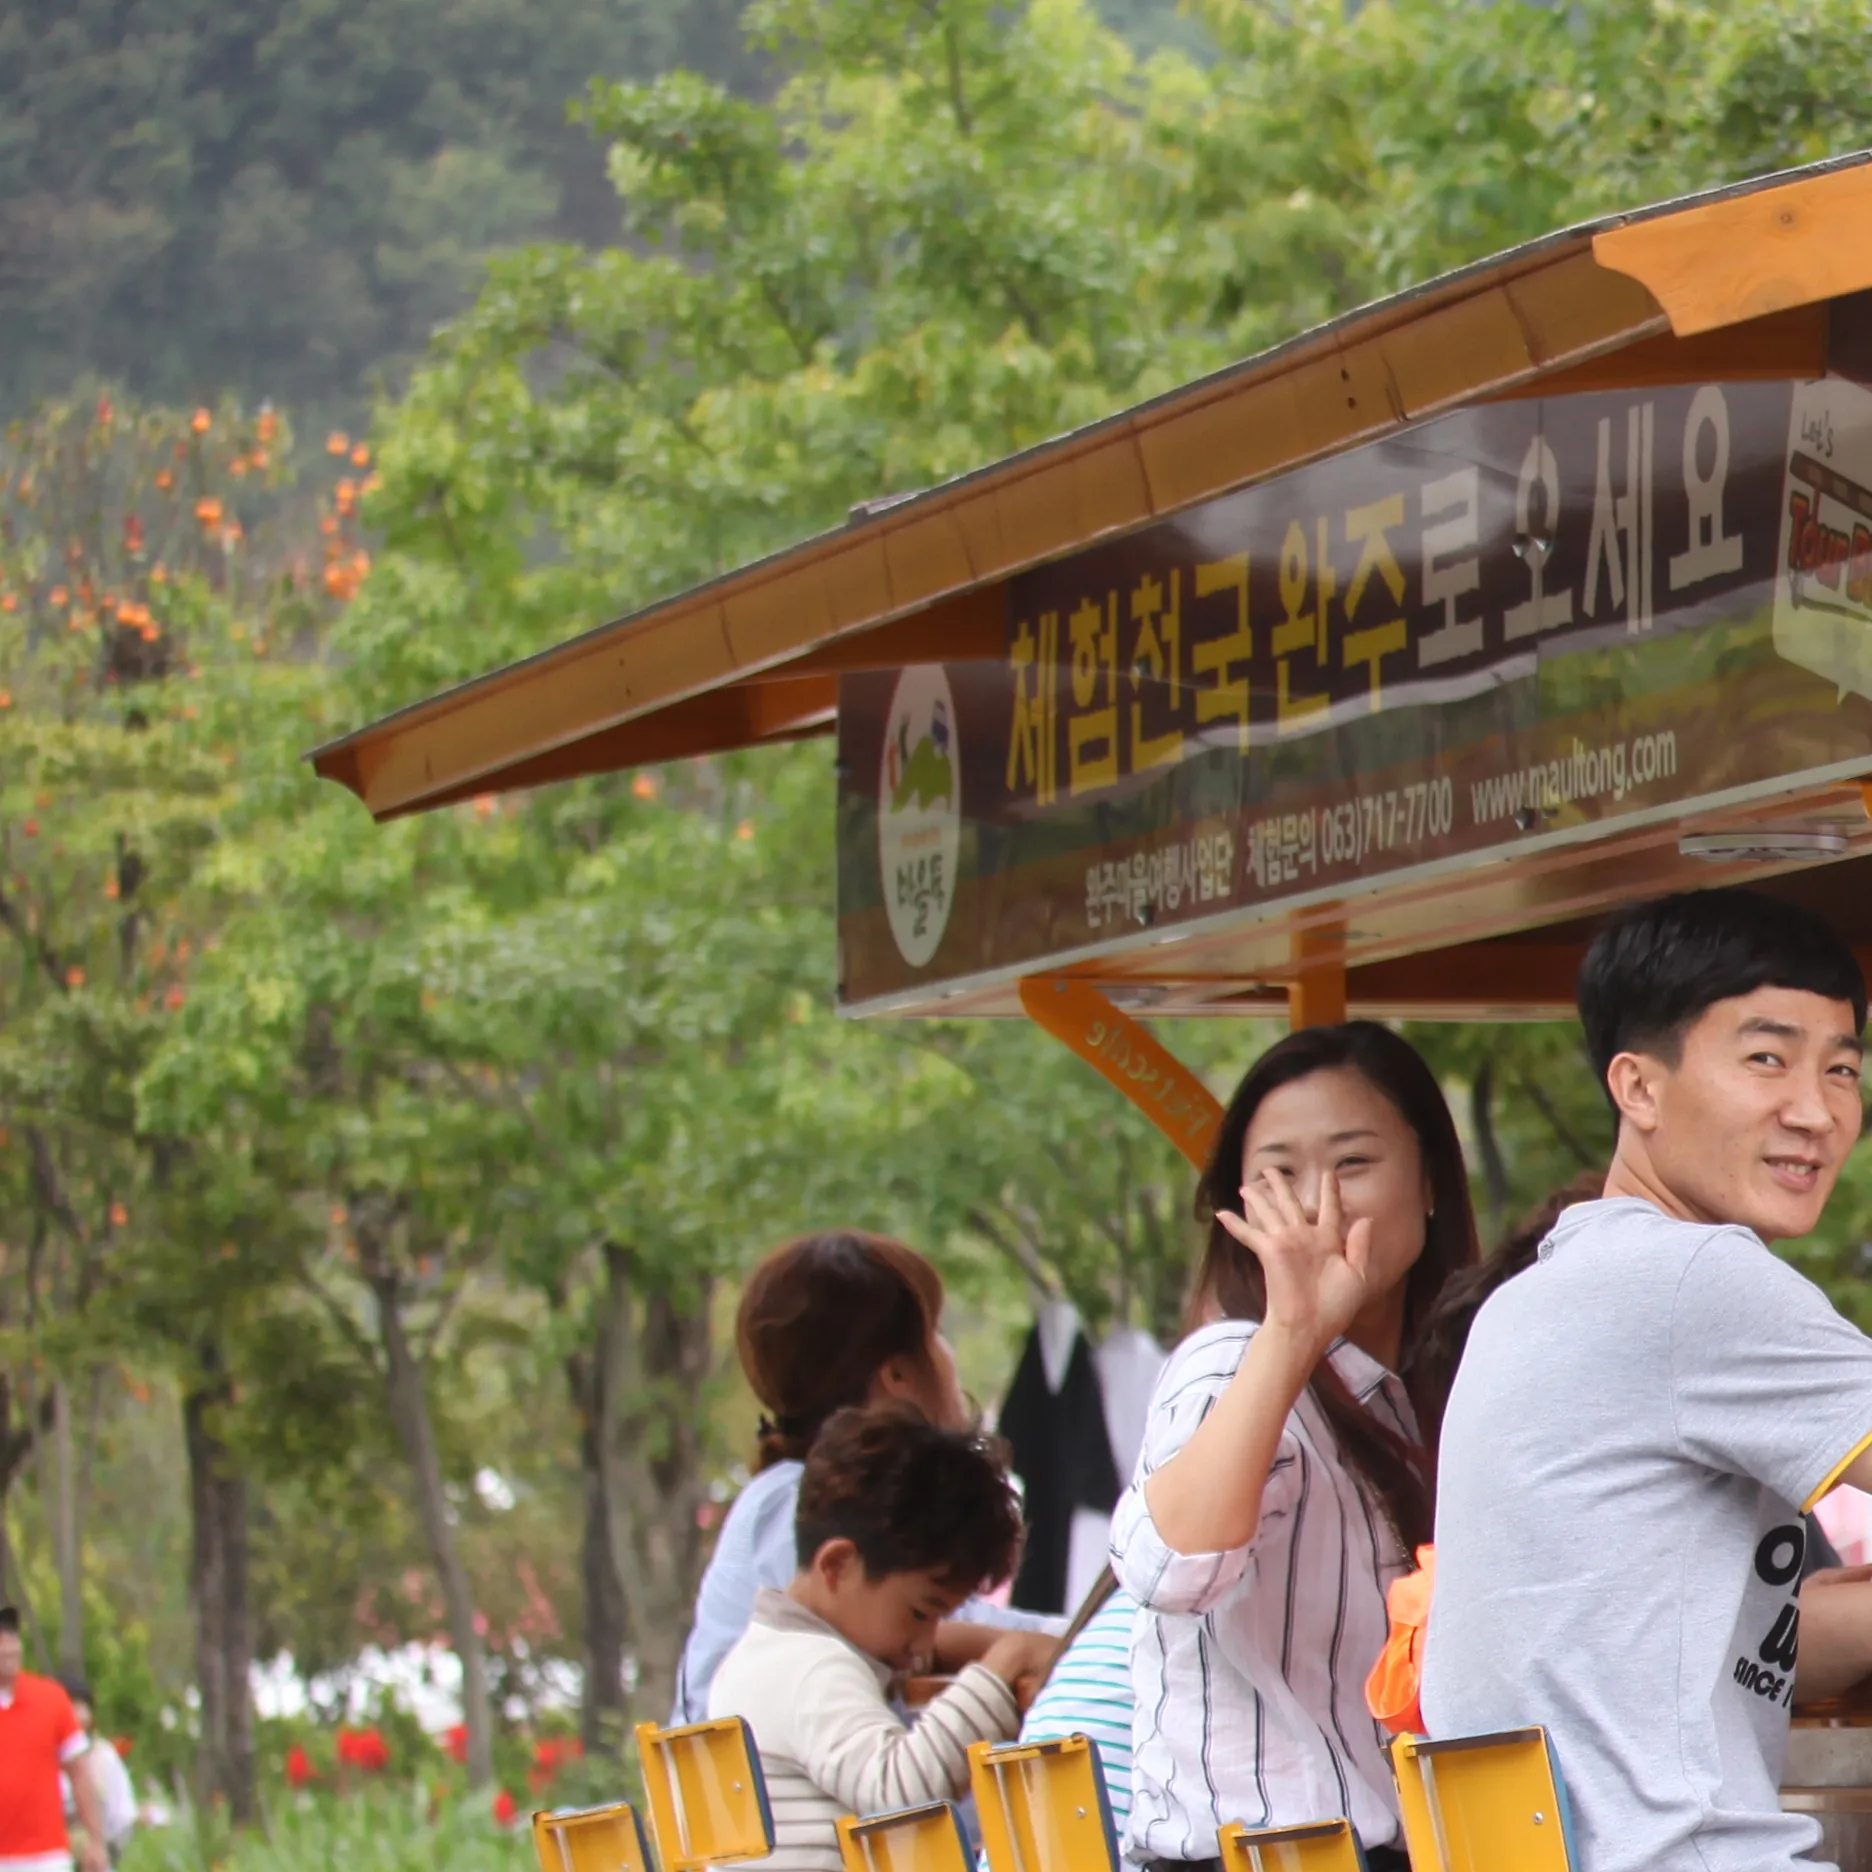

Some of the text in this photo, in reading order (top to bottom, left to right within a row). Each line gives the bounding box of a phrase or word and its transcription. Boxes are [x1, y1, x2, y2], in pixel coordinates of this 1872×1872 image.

[1005, 551, 1252, 806] 체험천국
[1246, 815, 1318, 888] 체험문의
[1321, 776, 1454, 866] 063)717-7700
[1470, 729, 1677, 827] www.maultong.com
